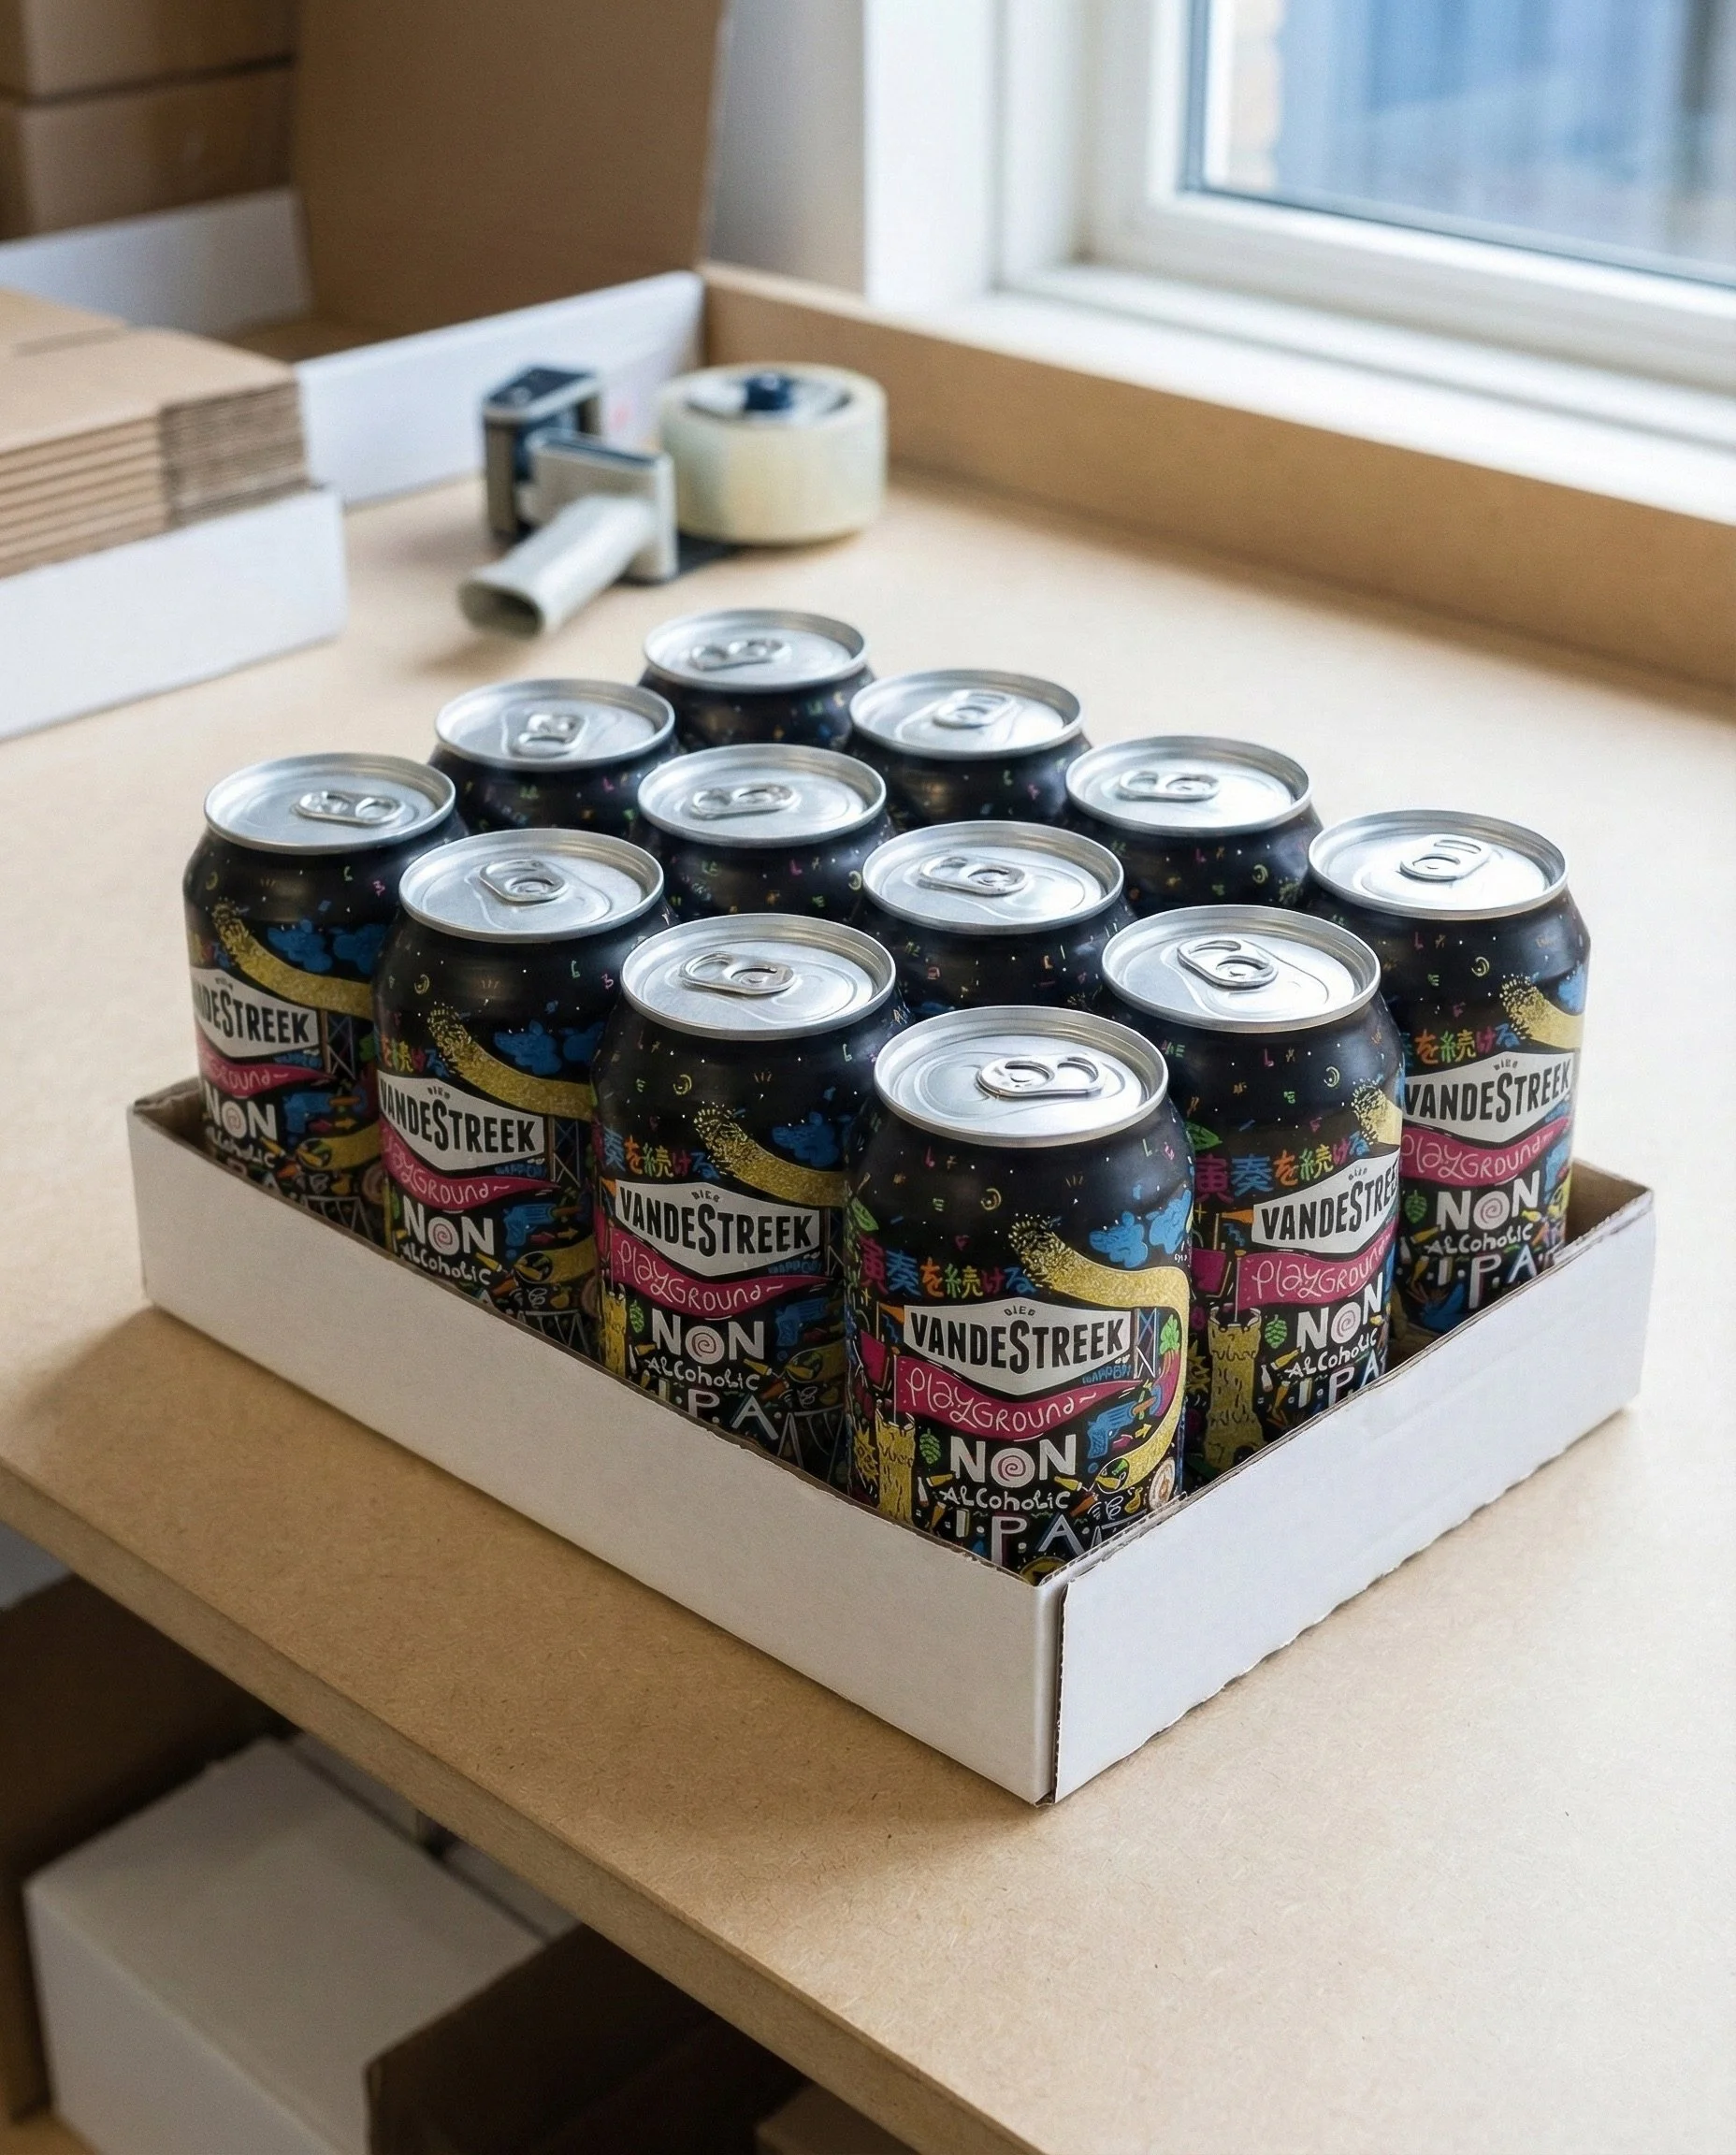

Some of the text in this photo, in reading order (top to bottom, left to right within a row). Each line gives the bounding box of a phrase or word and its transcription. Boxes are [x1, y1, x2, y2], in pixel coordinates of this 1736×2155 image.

[205, 1079, 278, 1140] NON
[380, 1078, 536, 1153] VANDESTREEK
[1405, 1058, 1571, 1122] VANDESTREEK
[403, 1195, 495, 1255] NON
[620, 1186, 814, 1257] VANDESTREEK
[1437, 1170, 1540, 1230] NON
[652, 1309, 765, 1365] NON
[1296, 1272, 1383, 1352] NON
[910, 1312, 1124, 1375] VANDESTREEK
[950, 1434, 1076, 1488] NON
